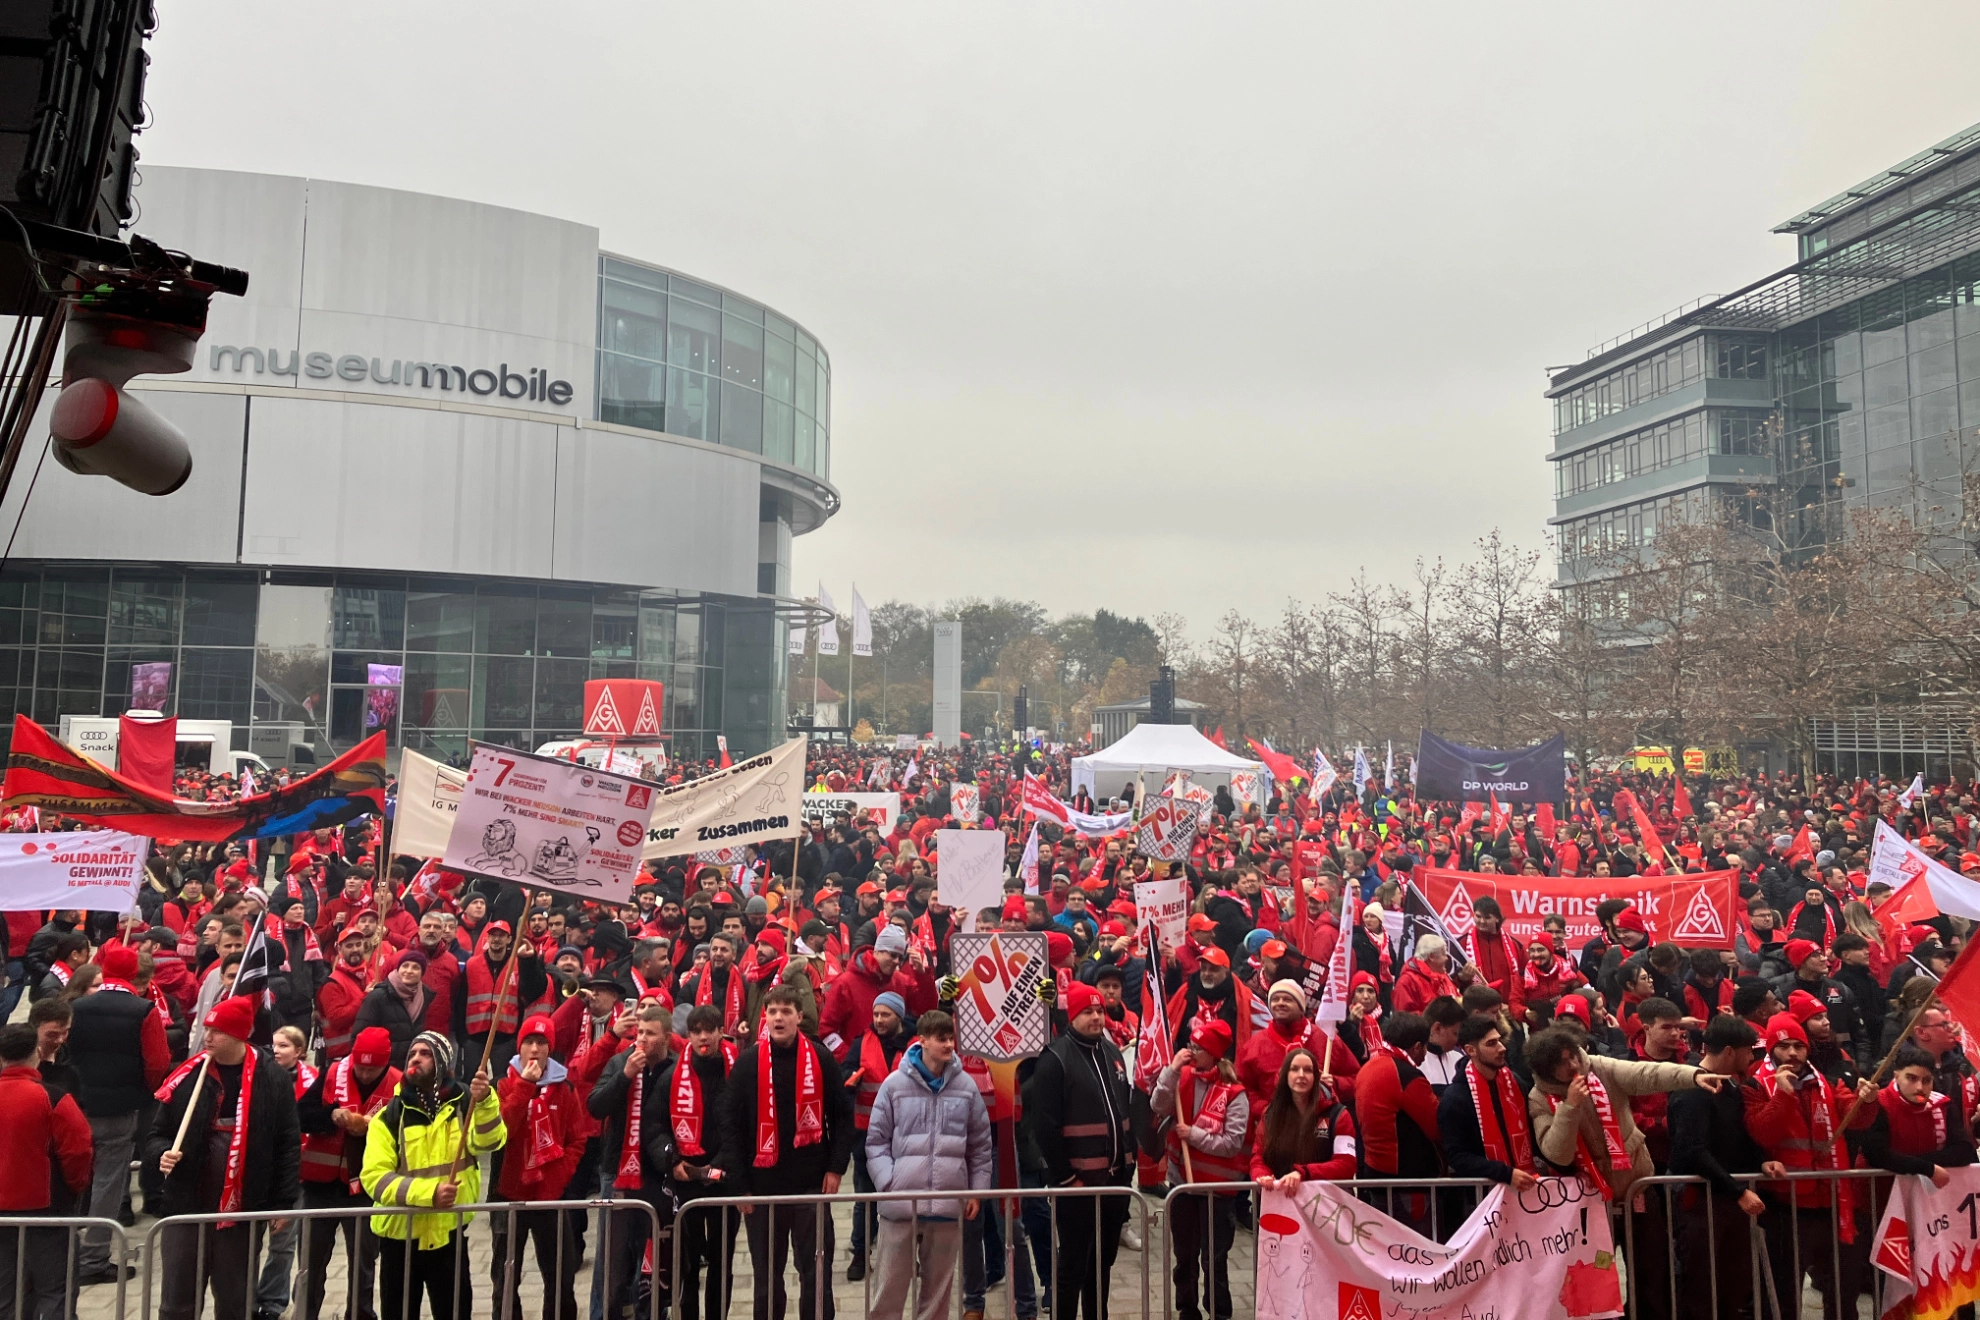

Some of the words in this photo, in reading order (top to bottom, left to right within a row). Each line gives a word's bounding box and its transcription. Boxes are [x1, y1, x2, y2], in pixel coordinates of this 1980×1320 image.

[80, 743, 114, 752] Snack
[494, 758, 516, 787] 7
[1462, 781, 1481, 790] DP
[1483, 781, 1529, 791] WORLD
[503, 803, 517, 815] 7%
[517, 808, 539, 819] MEHR
[561, 807, 595, 821] ARBEITEN
[1140, 800, 1188, 842] 7%
[649, 827, 680, 842] ker
[697, 815, 789, 841] Zusammen
[1167, 827, 1179, 841] AUF
[1177, 812, 1196, 831] EINEN
[1171, 823, 1195, 846] STREICH
[51, 851, 136, 865] SOLIDARITÄT
[69, 866, 133, 878] GEWINNT!
[77, 879, 102, 887] METALL
[113, 879, 131, 888] AUDI
[1162, 899, 1185, 917] MEHR
[1510, 889, 1661, 916] Warnsteik
[1564, 922, 1603, 939] gute
[954, 936, 1029, 1026] 7%
[1000, 990, 1019, 1018] AUF
[1014, 956, 1043, 994] EINEN
[1302, 1193, 1383, 1256] 170€
[1541, 1207, 1588, 1256] mehr!
[1926, 1213, 1950, 1237] uns
